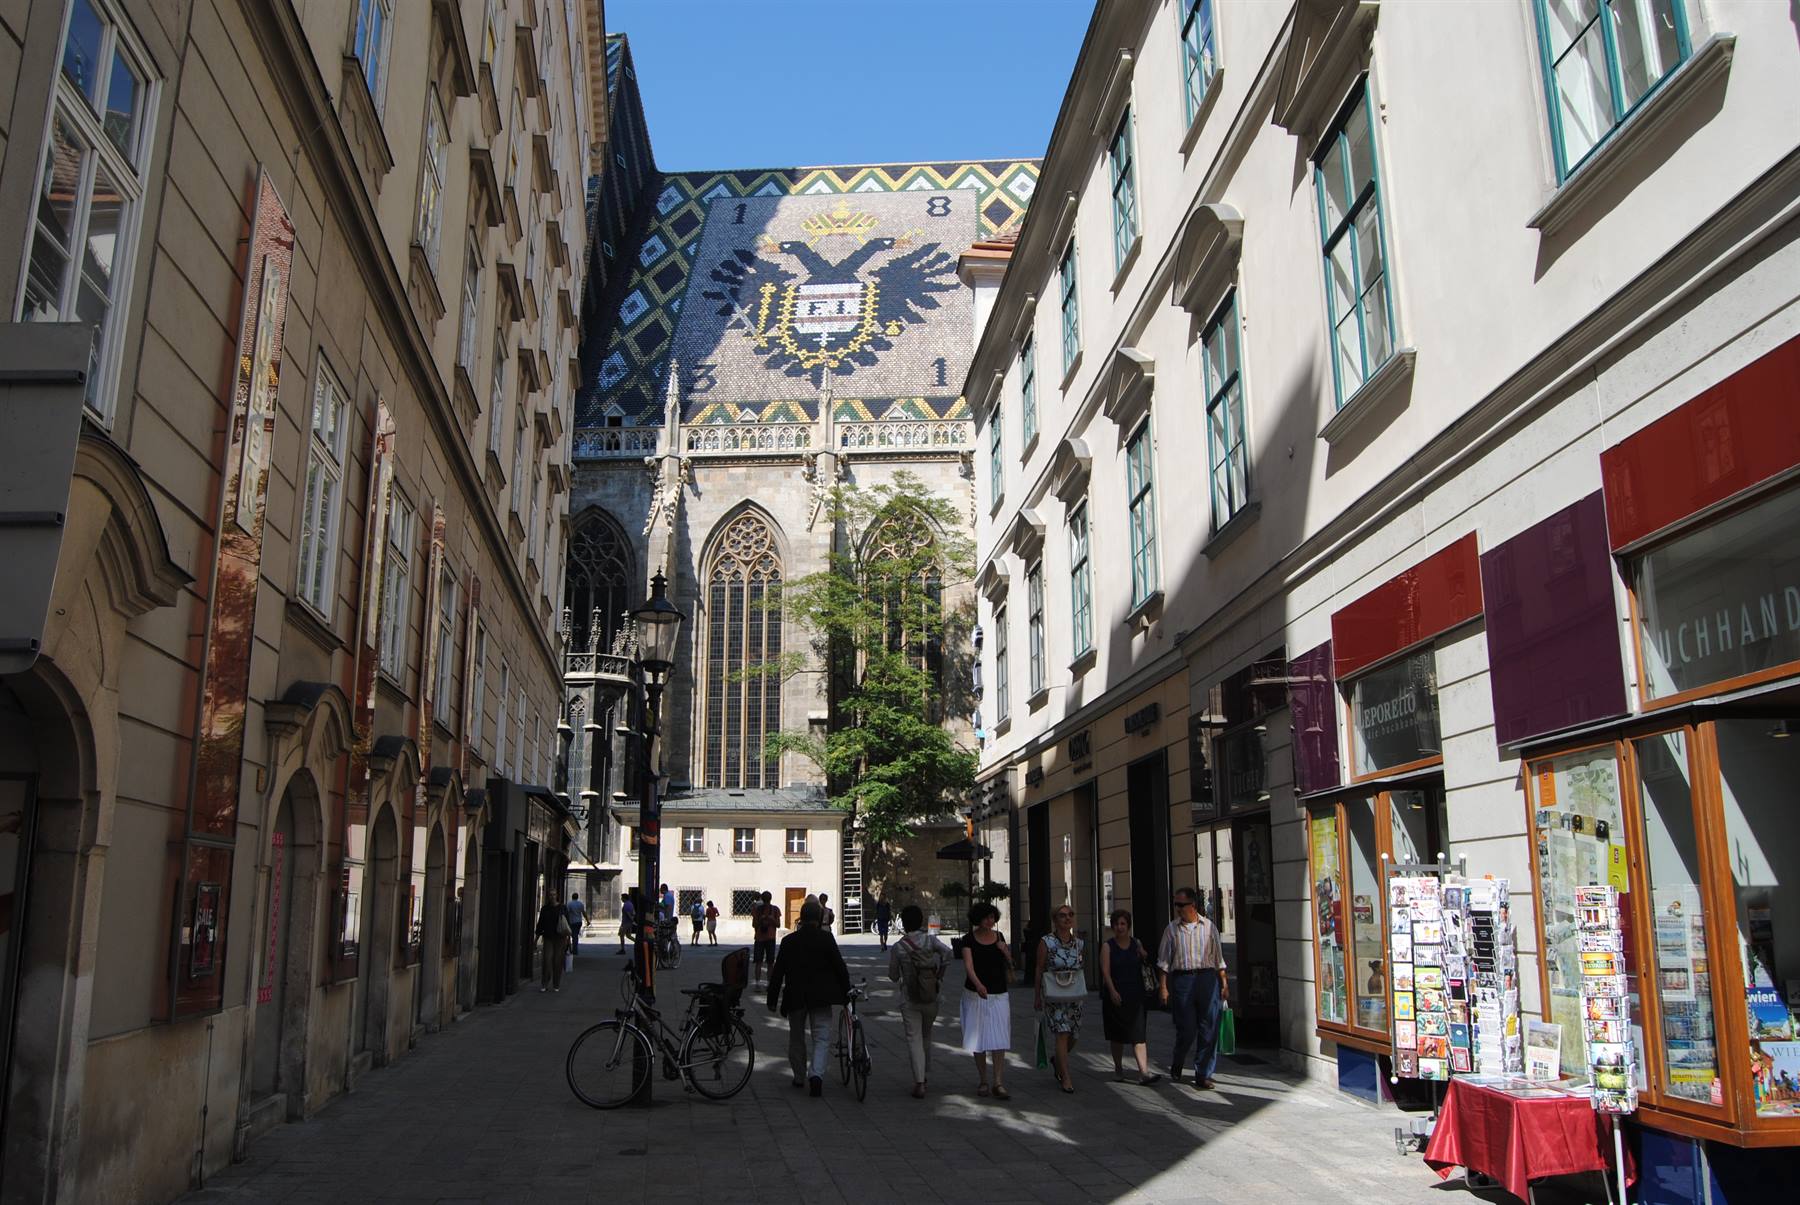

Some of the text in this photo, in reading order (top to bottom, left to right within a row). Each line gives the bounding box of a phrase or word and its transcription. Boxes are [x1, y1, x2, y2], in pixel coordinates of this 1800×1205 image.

[731, 196, 952, 224] 1 8
[931, 357, 948, 387] 1
[1747, 990, 1777, 1004] wien
